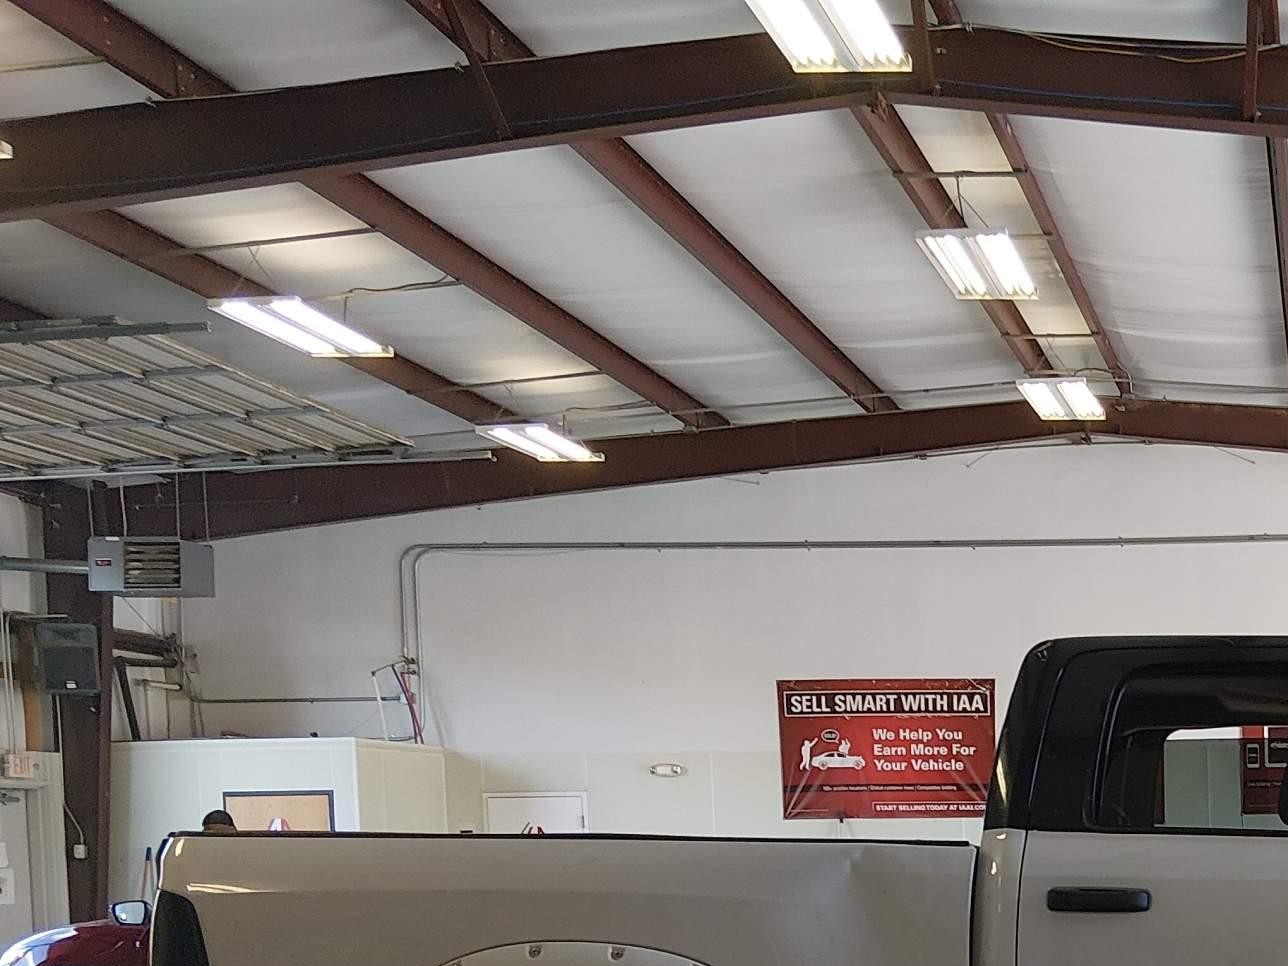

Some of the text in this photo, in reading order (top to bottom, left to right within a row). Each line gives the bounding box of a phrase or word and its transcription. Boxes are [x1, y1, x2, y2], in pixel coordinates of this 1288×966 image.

[790, 694, 984, 713] SELL SMART WITH IAA
[872, 728, 962, 741] We Help You
[873, 743, 976, 756] Earn More For
[874, 759, 964, 771] Your Vehicle
